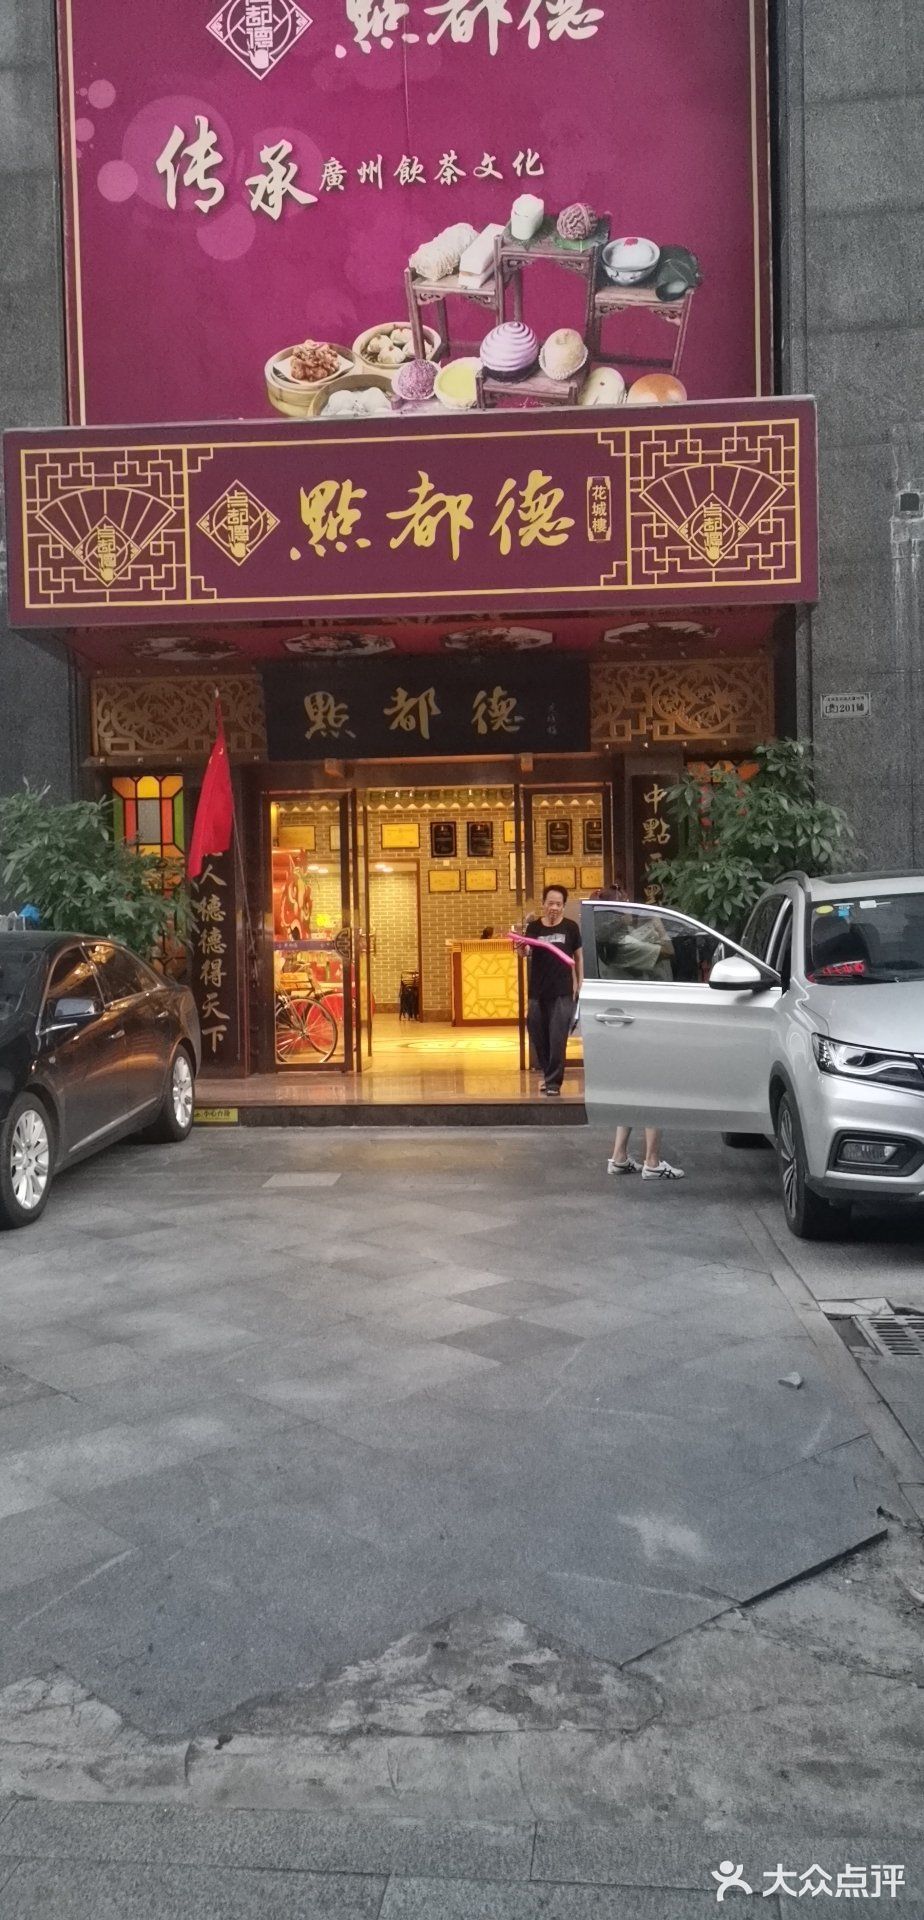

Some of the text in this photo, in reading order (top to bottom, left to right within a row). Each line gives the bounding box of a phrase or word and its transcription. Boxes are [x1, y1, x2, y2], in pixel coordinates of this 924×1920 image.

[156, 115, 544, 221] 传承 廣州飲茶文化
[290, 469, 576, 562] 點都德
[592, 485, 607, 533] 花城樓
[303, 685, 526, 740] 點都德
